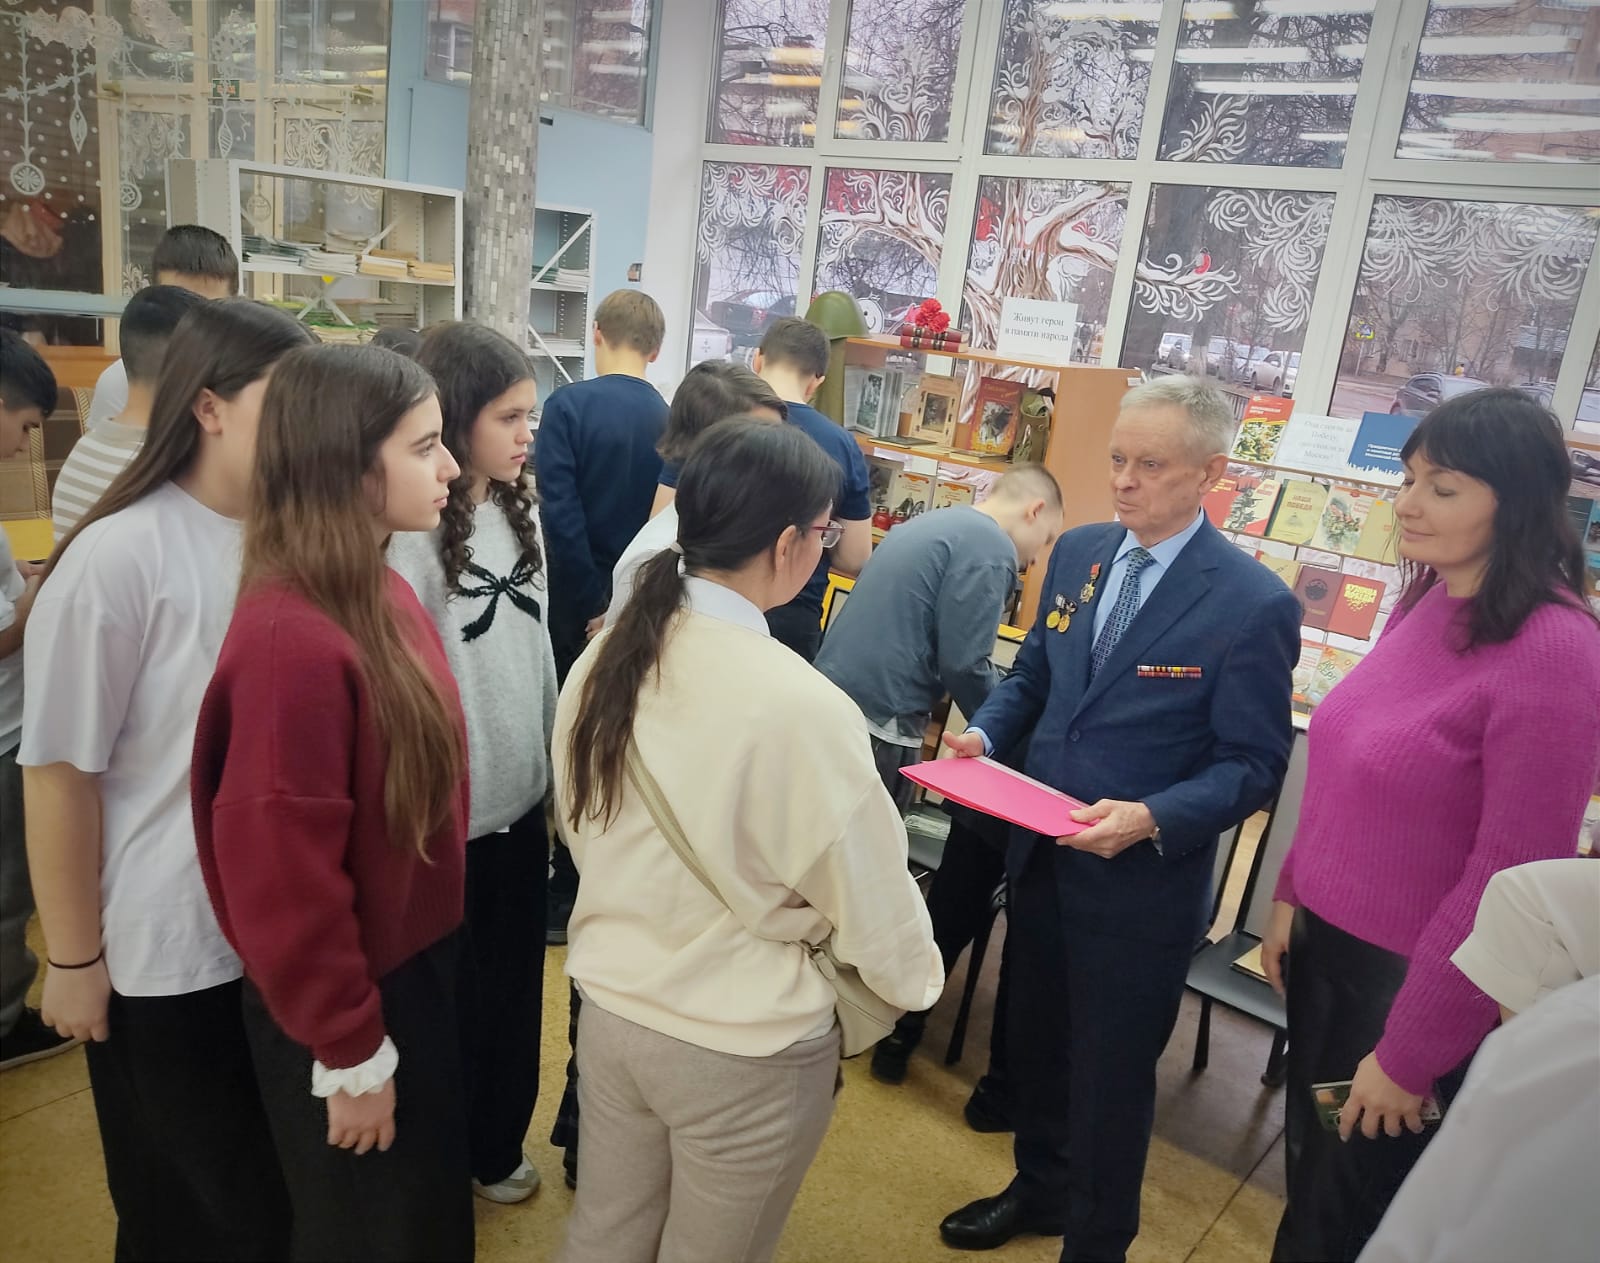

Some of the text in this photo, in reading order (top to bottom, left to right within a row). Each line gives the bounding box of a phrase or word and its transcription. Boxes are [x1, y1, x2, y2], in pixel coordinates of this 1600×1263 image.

[1013, 312, 1064, 327] Живут герои
[1011, 328, 1039, 338] памяти
[1041, 331, 1069, 342] народа
